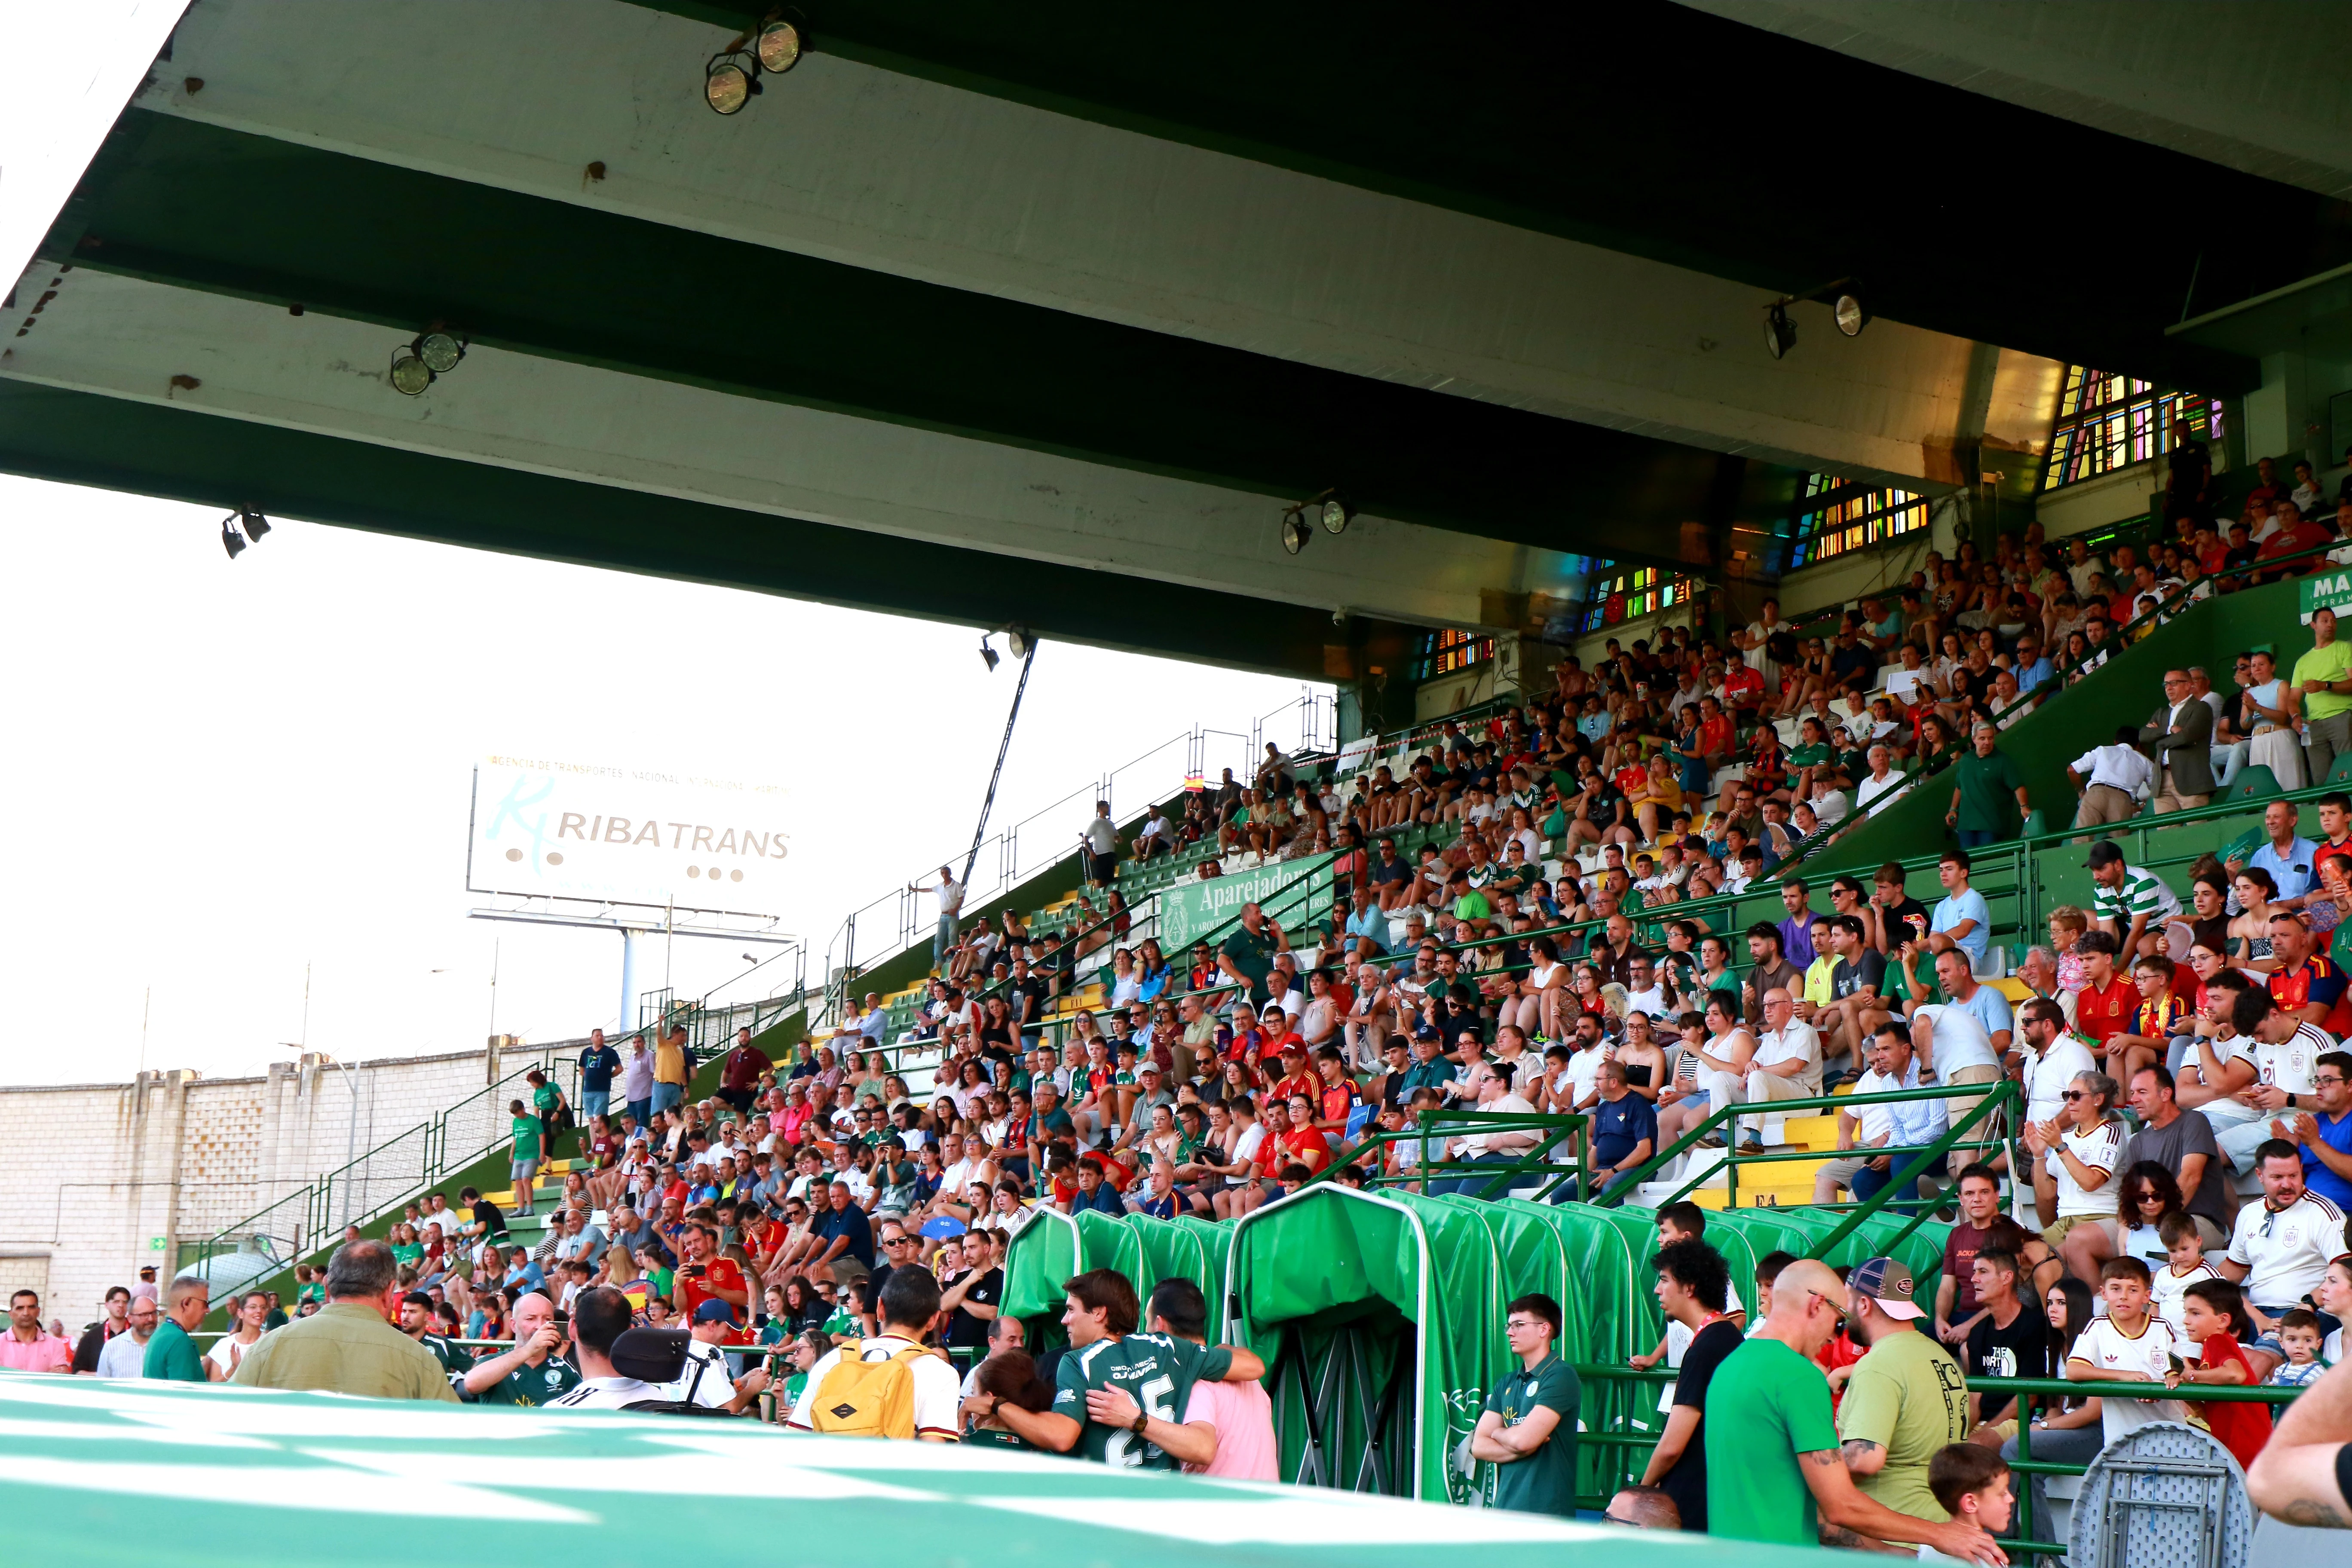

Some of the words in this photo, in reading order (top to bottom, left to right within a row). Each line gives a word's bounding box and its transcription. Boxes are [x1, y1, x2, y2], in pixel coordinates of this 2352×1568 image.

[492, 756, 535, 769] AGENCIA
[538, 760, 551, 771] DE
[554, 762, 623, 778] TRANSPORTES
[631, 770, 680, 784] NACIONAL
[686, 776, 745, 791] INTERNACIONA
[557, 812, 790, 860] RIBATRANS
[1992, 1347, 2006, 1358] THE
